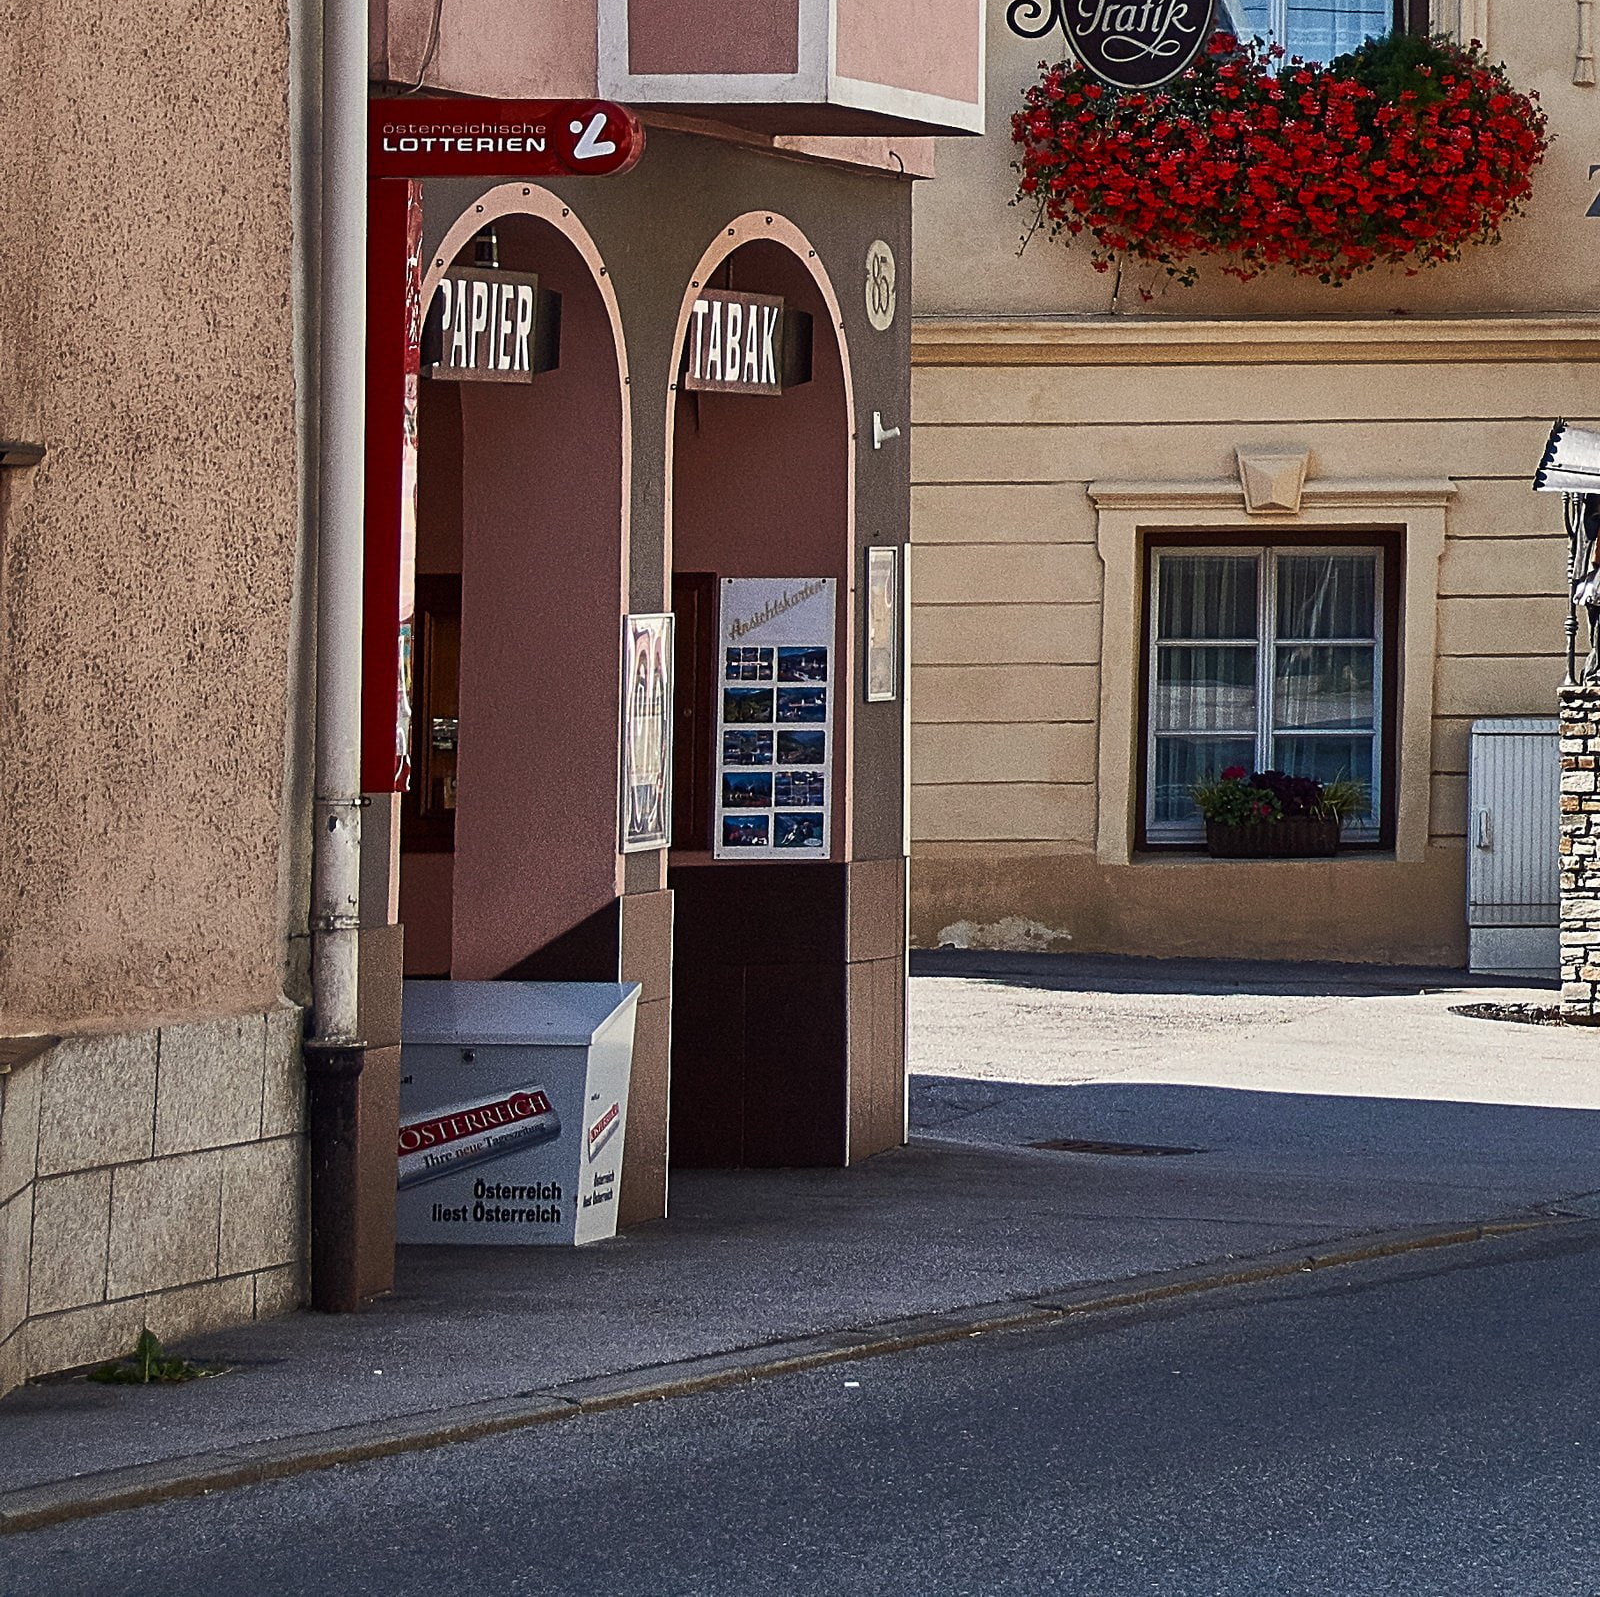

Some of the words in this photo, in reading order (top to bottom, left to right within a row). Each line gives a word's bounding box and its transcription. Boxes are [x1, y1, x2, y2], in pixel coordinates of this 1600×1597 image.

[382, 122, 547, 134] österreichische
[383, 137, 546, 152] LOTTERIEN
[433, 278, 533, 371] PAPIER
[692, 299, 779, 385] TABAK
[399, 1095, 547, 1150] ÖSTERREICH
[423, 1152, 453, 1170] Ihre
[455, 1140, 484, 1158] neue
[473, 1178, 562, 1201] Österreich
[431, 1203, 469, 1223] liest
[472, 1201, 562, 1223] Österreich
